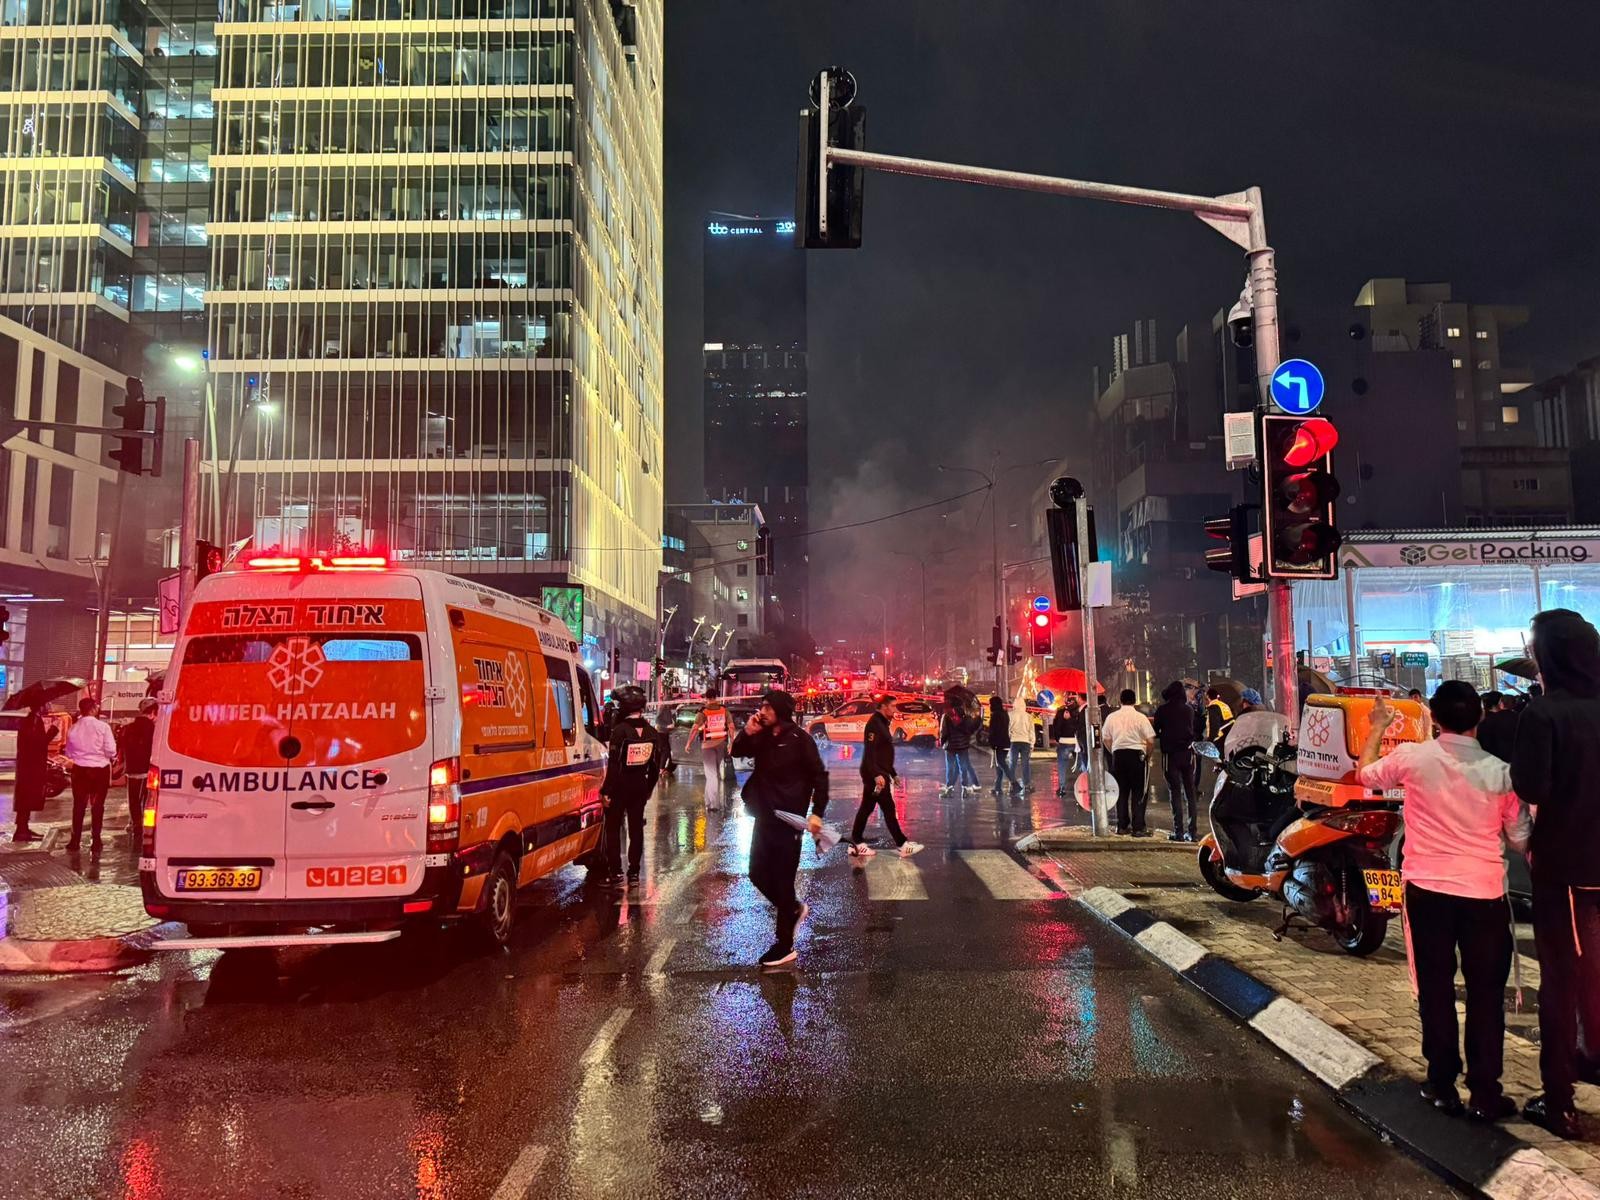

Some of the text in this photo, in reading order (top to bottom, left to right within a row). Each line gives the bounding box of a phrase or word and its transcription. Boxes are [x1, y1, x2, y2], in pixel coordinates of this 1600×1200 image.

[730, 227, 763, 235] CENTRAL
[222, 604, 386, 629] איחוד הצלה
[538, 630, 570, 653] AMBULANCE
[473, 657, 504, 683] איחוד
[189, 702, 396, 722] UNITED HATZALAH
[1298, 748, 1339, 764] איחוד הצלה
[163, 773, 178, 785] 19
[199, 769, 377, 793] AMBULANCE
[477, 806, 488, 828] 19
[331, 869, 402, 884] 1221
[1381, 888, 1394, 901] 84
